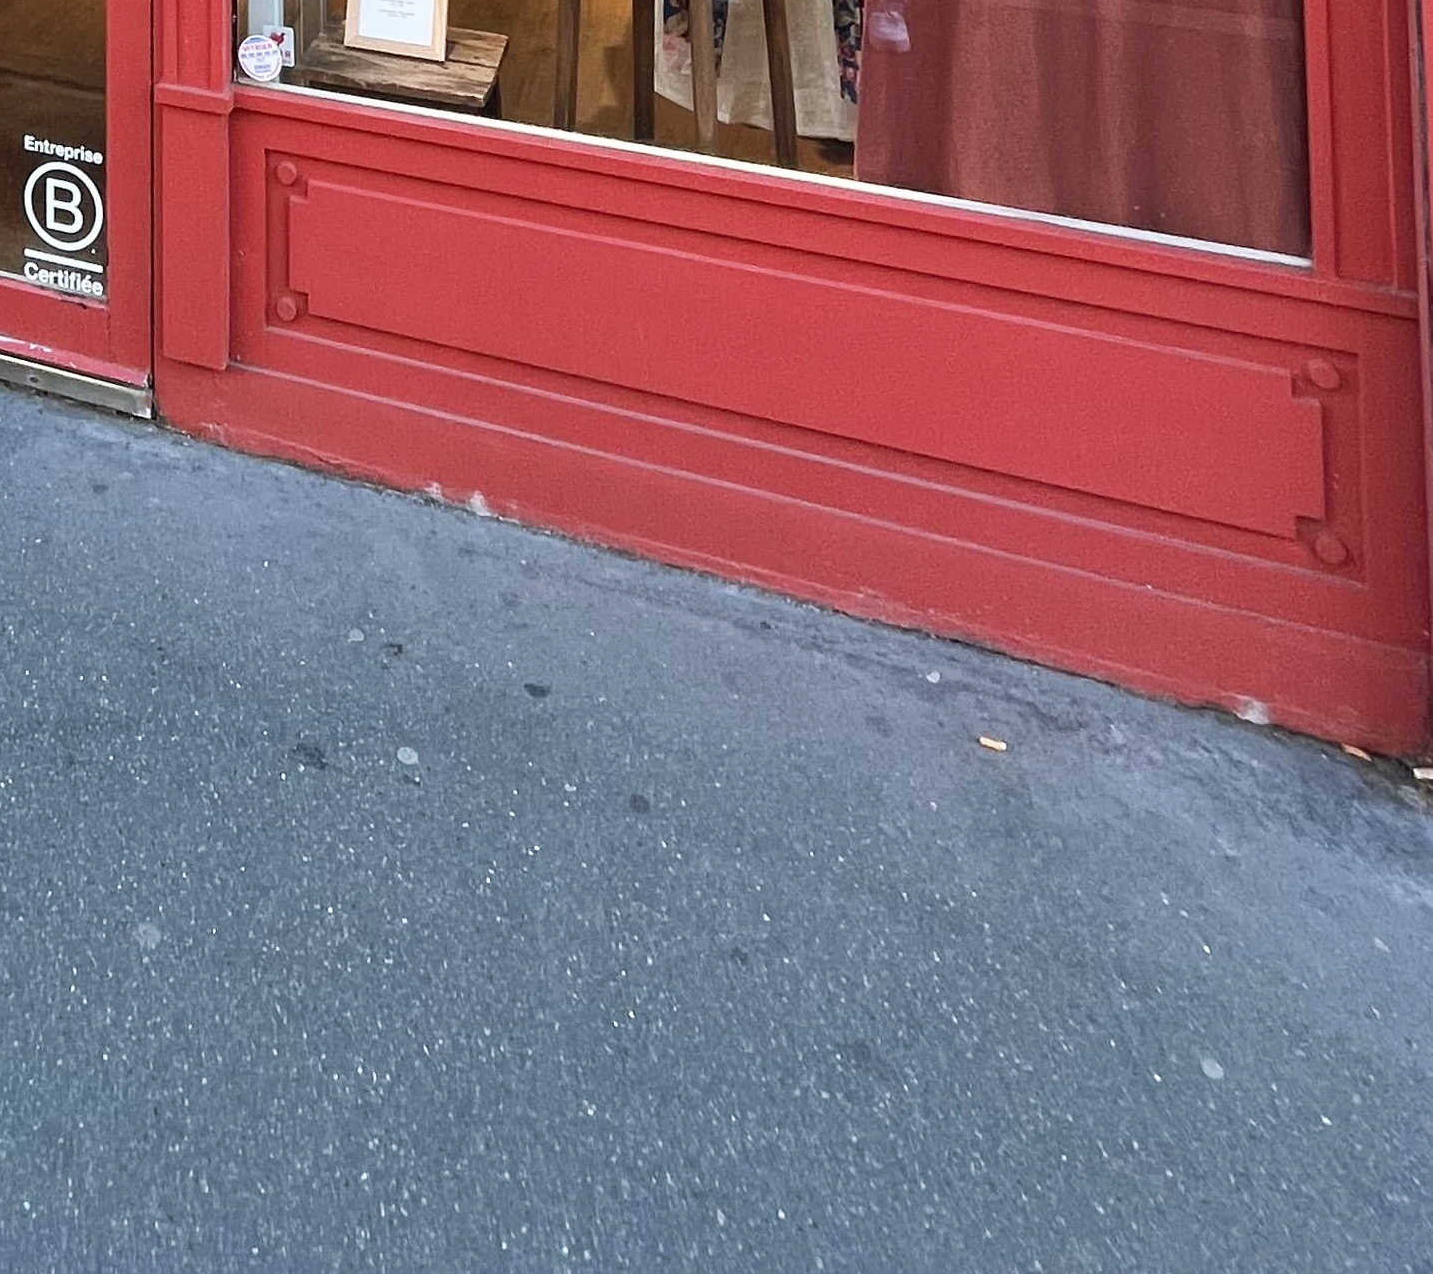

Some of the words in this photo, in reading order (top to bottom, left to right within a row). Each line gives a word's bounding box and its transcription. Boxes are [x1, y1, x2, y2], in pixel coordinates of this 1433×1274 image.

[23, 134, 103, 165] Entreprise
[45, 177, 84, 234] B
[23, 261, 104, 297] Certifiée
